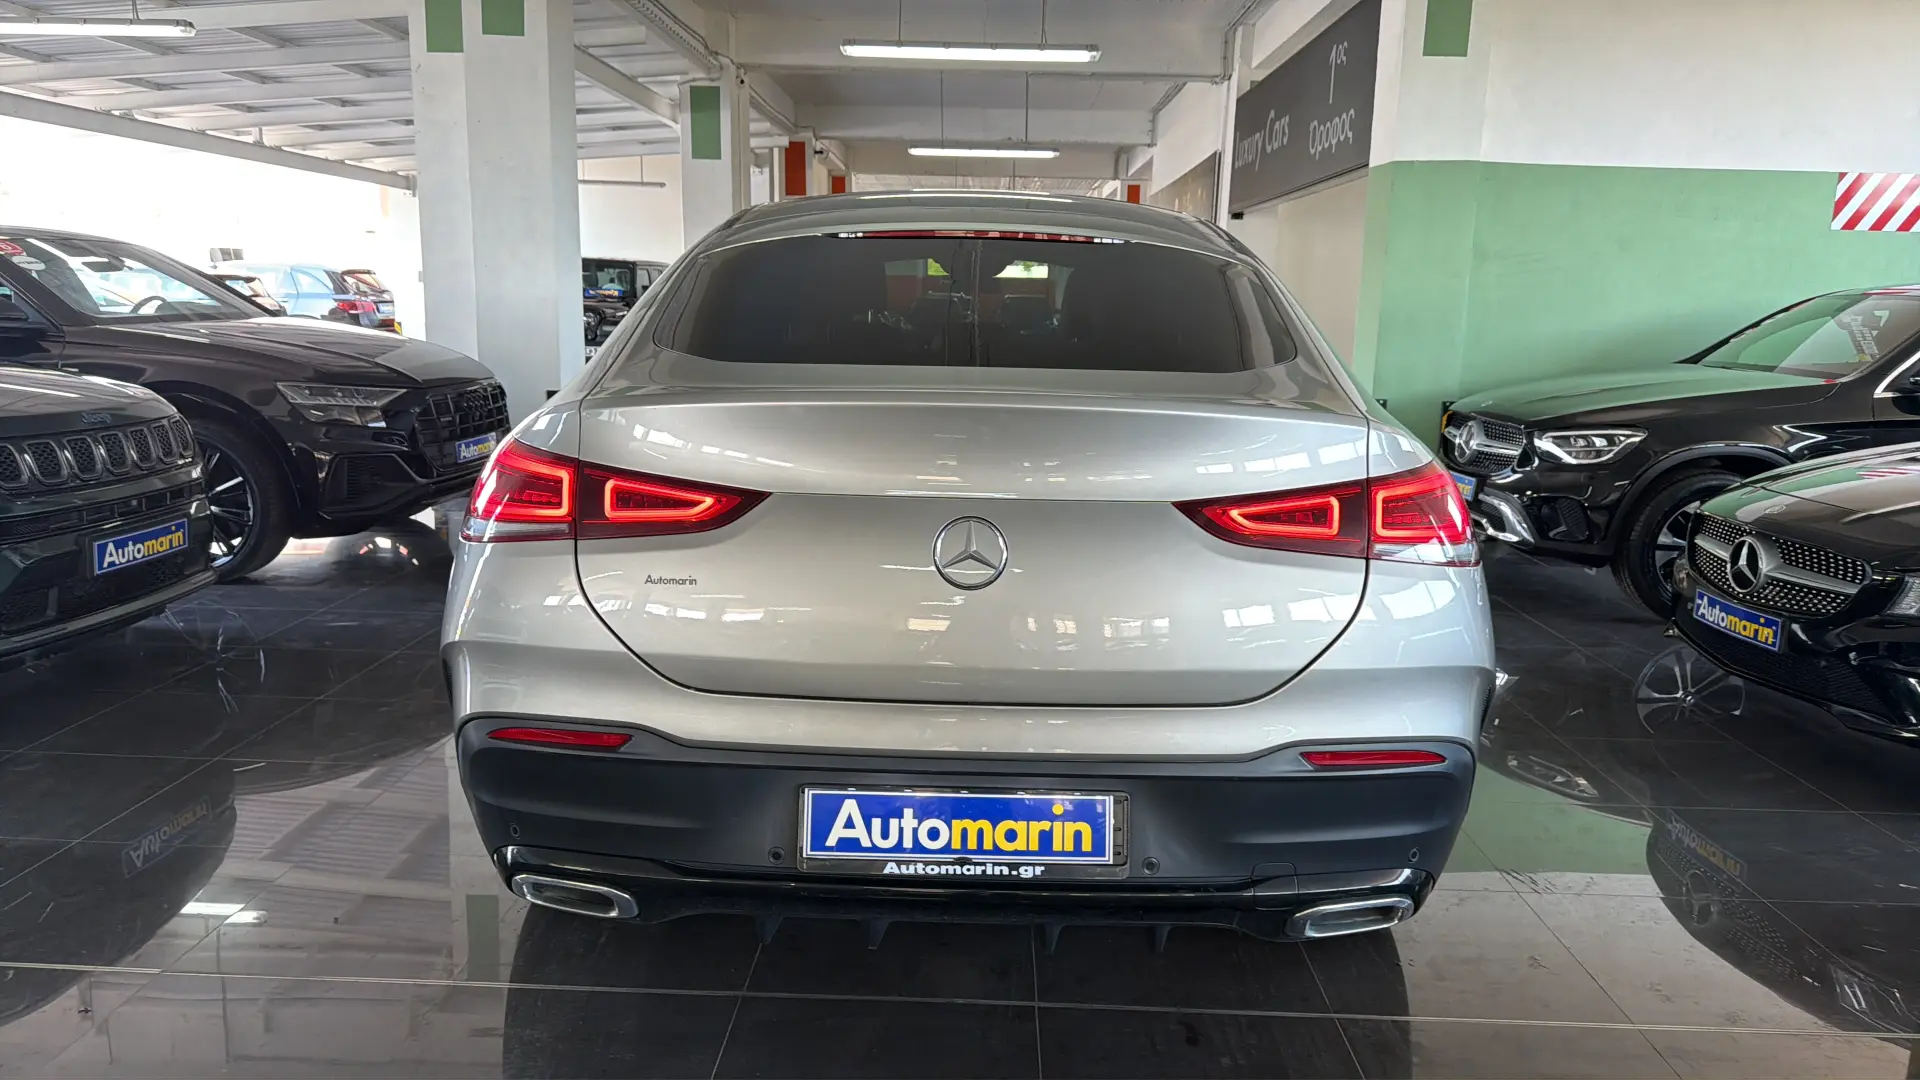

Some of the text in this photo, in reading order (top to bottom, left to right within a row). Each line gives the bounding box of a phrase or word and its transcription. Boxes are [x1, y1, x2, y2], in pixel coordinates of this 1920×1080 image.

[1234, 109, 1290, 173] Luxury Cars
[102, 526, 184, 568] Automarin
[644, 574, 697, 585] Automarin
[1697, 595, 1774, 645] Automarin
[825, 798, 1092, 852] Automarin
[883, 861, 1045, 877] Automarin.gr
